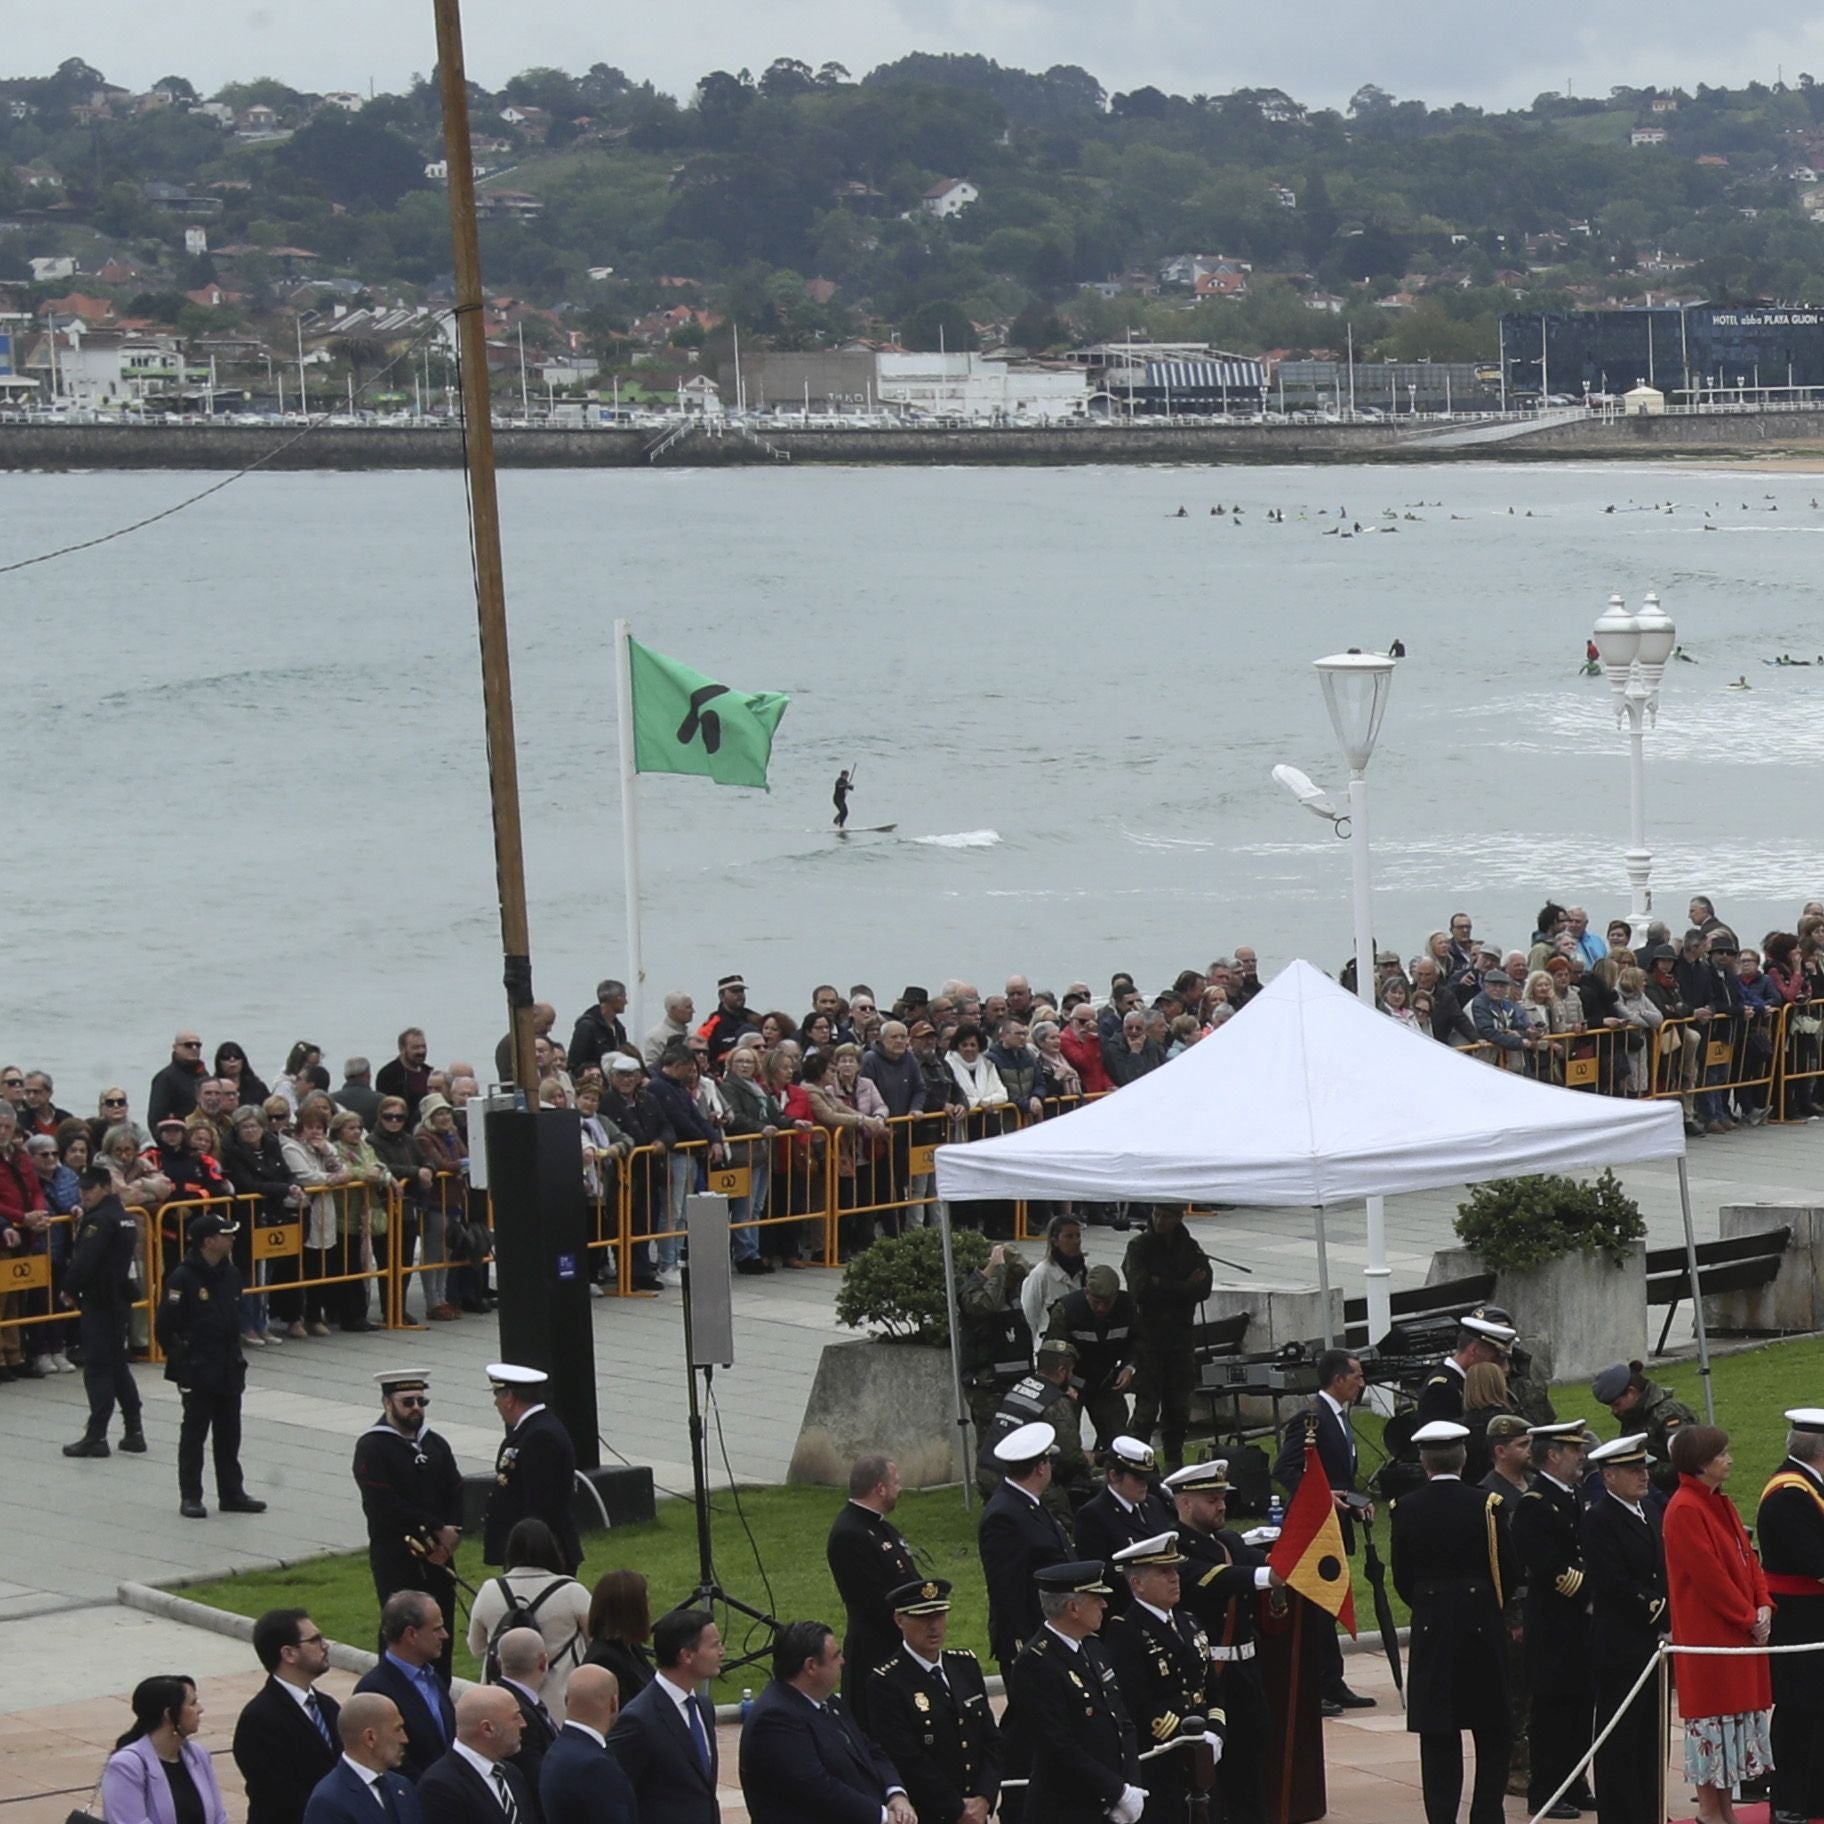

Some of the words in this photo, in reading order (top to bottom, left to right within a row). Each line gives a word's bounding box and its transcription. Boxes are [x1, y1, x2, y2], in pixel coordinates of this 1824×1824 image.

[1712, 314, 1739, 326] HOTEL
[1741, 314, 1762, 325] abba
[1764, 314, 1790, 325] PLAYA
